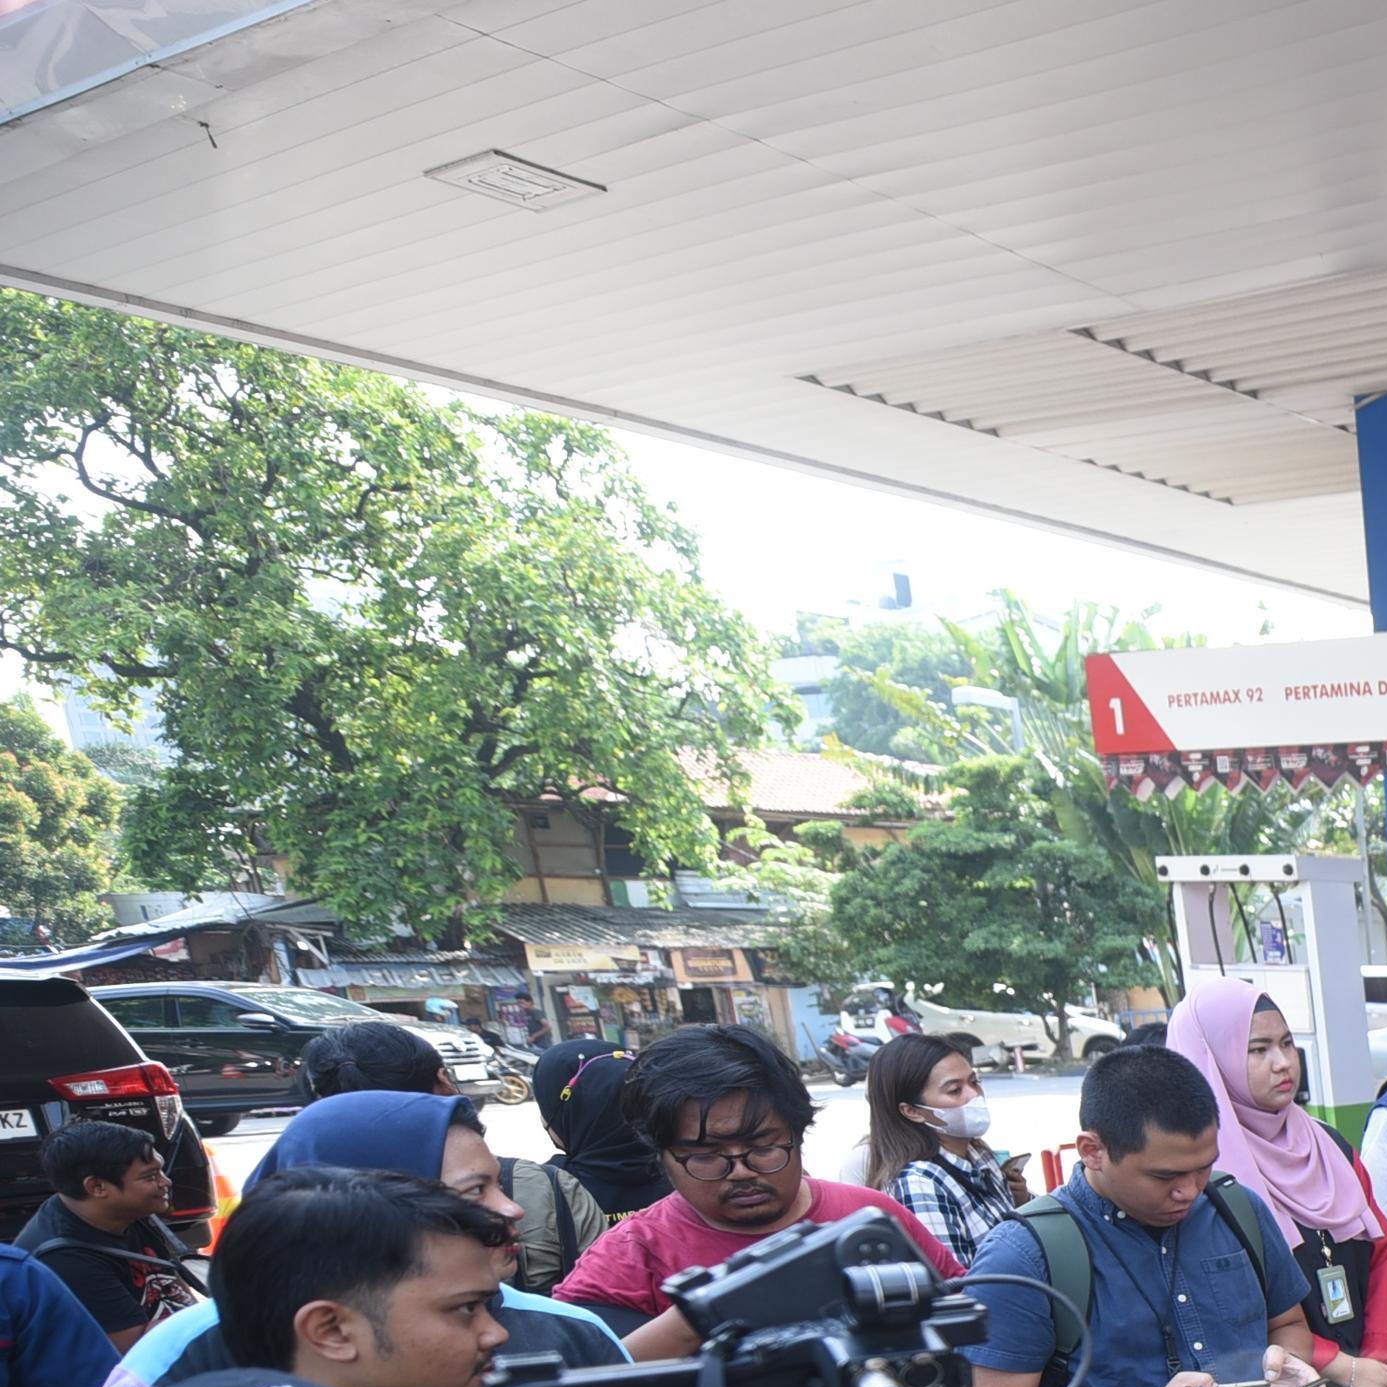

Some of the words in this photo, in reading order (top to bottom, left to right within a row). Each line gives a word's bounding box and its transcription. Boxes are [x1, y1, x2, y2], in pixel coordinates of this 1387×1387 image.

[1167, 688, 1242, 709] PERTAMAX
[1246, 687, 1264, 702] 92
[1284, 681, 1373, 701] PERTAMINA
[1108, 698, 1125, 735] 1
